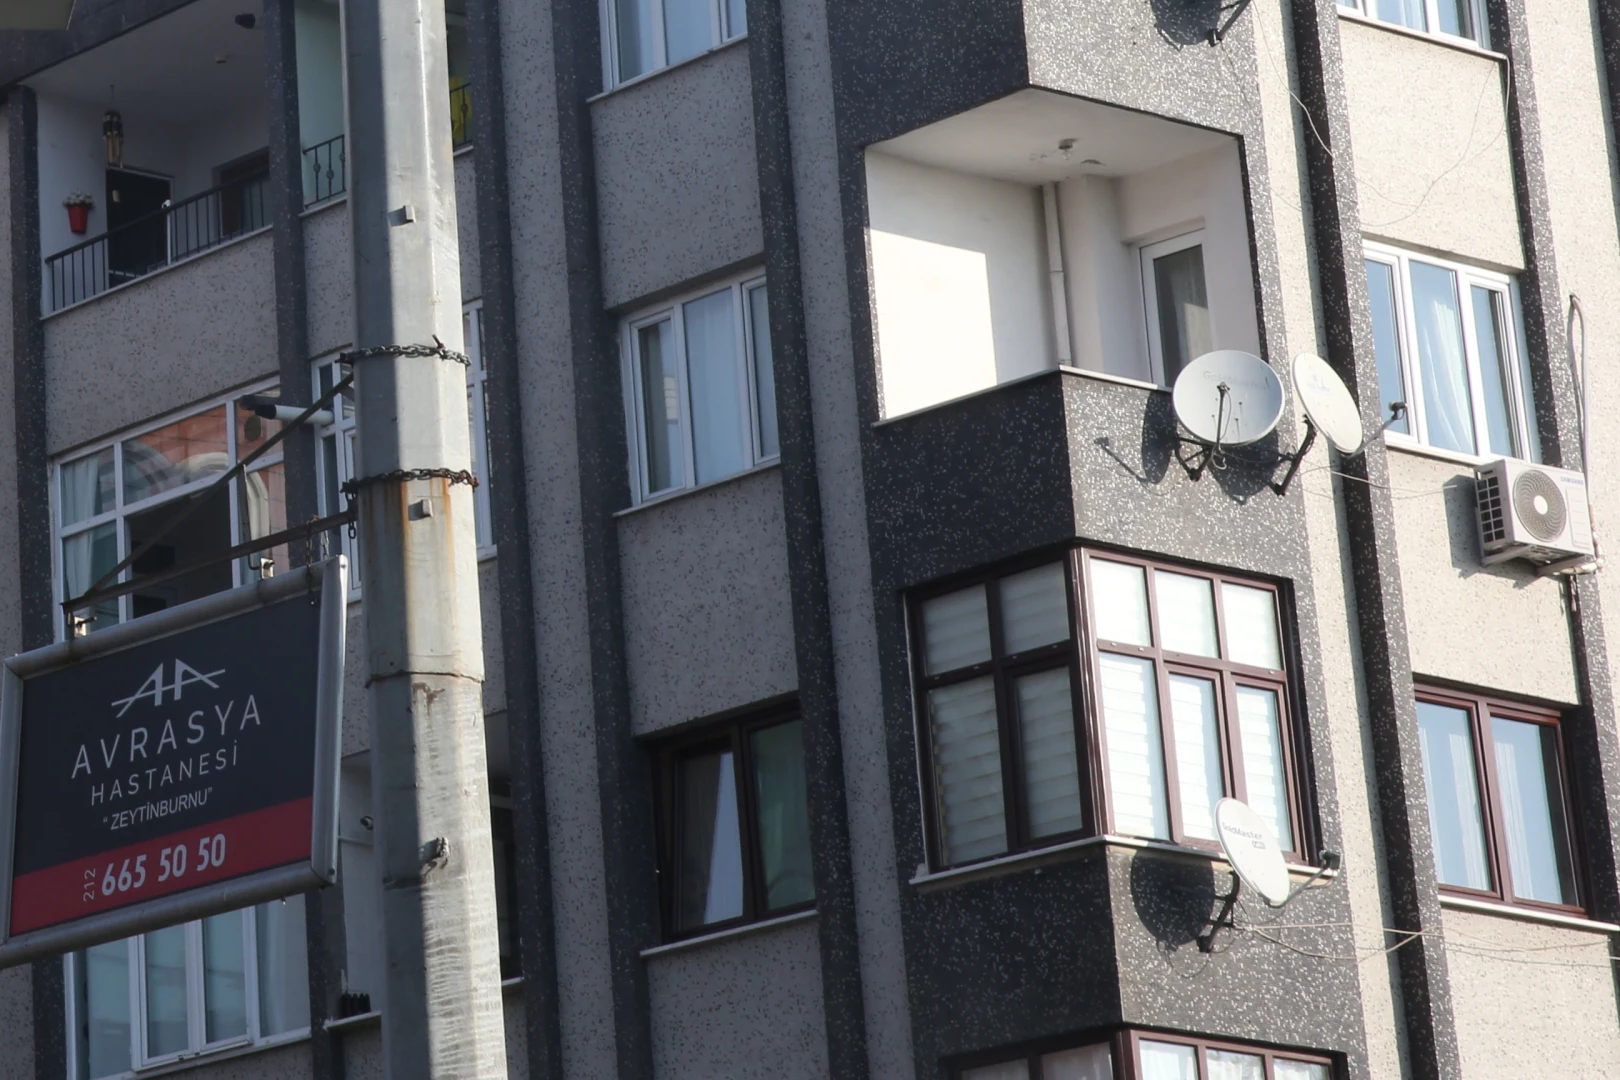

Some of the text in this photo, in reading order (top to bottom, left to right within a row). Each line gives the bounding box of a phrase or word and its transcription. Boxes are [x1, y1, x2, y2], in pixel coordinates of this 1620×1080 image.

[71, 694, 261, 779] AVRASYA
[91, 739, 238, 806] HASTANESİ
[83, 833, 226, 902] 212 665 50 50
